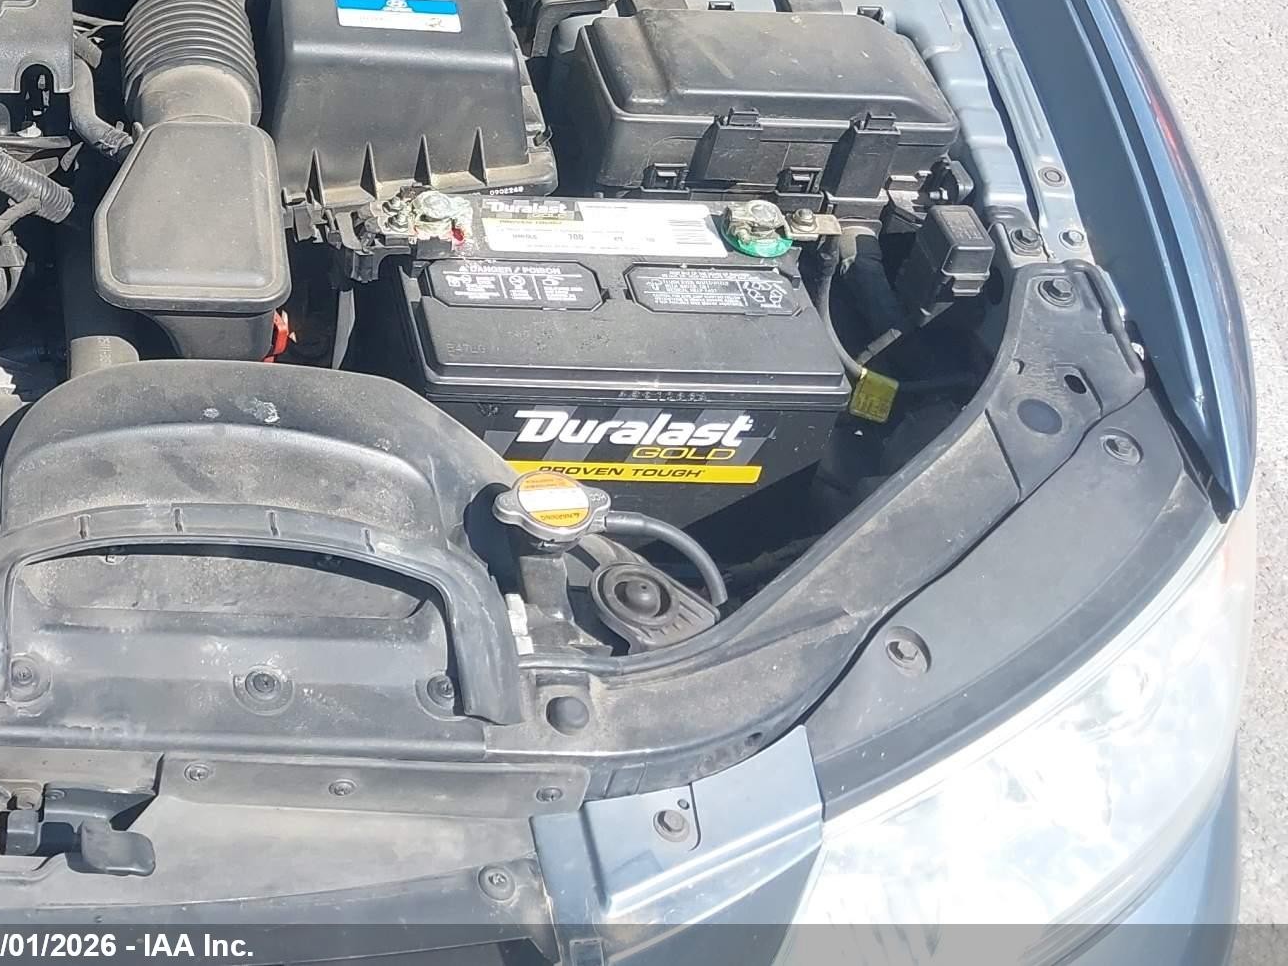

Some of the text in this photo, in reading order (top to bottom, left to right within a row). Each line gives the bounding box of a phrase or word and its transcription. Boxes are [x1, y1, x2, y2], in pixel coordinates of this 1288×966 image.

[485, 201, 568, 215] Duralast
[514, 410, 753, 447] Duralast
[632, 447, 736, 460] GOLD
[632, 468, 701, 479] TOUGH
